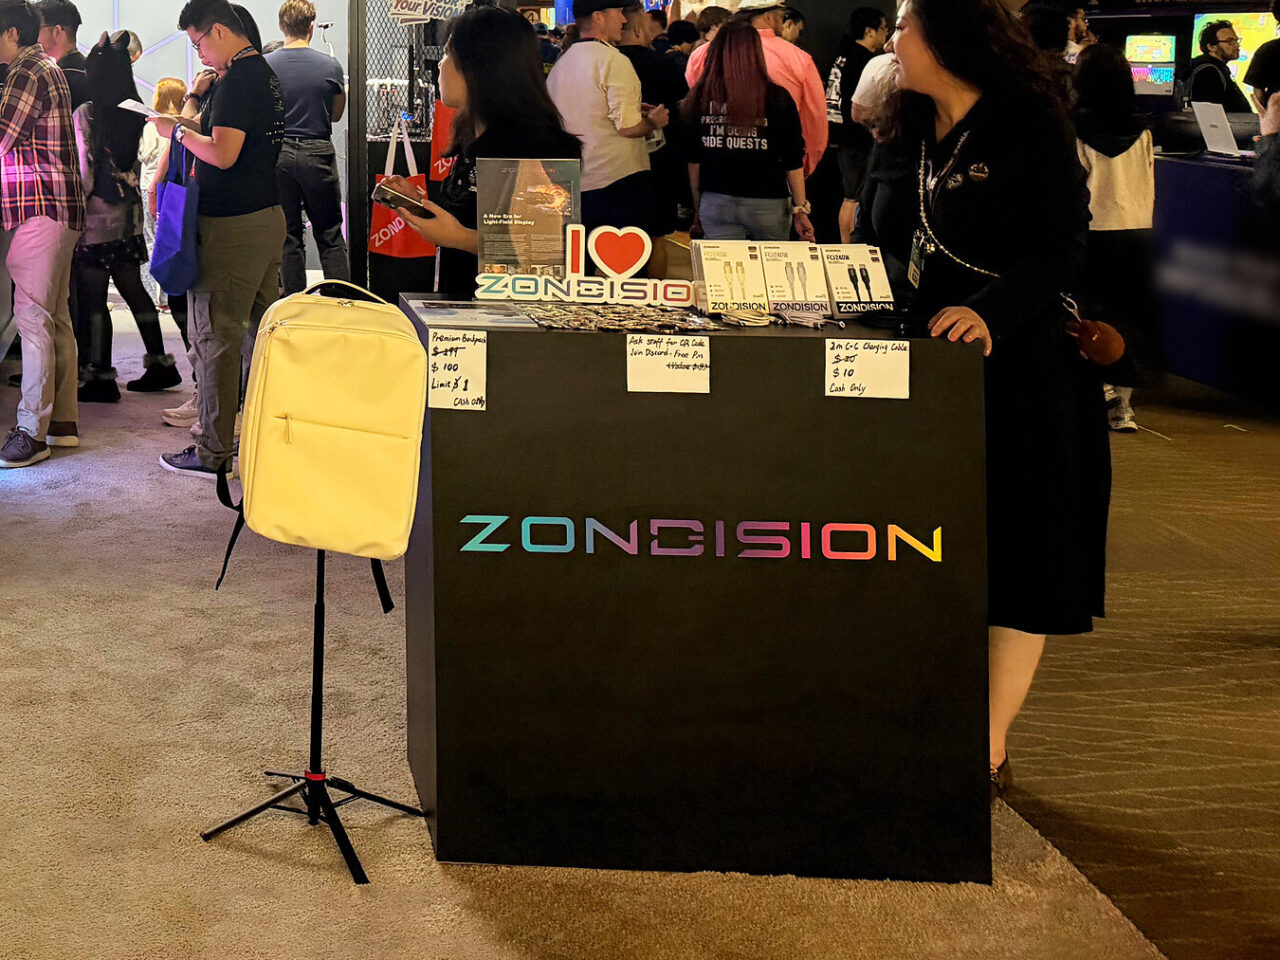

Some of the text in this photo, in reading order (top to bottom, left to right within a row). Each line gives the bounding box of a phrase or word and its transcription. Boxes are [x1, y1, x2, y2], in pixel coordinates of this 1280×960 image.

[710, 125, 724, 136] I'M
[702, 136, 768, 150] SIDE QUESTS
[571, 229, 580, 273] I
[481, 275, 691, 302] ZONDISIO
[711, 302, 766, 312] ZODISION
[773, 302, 828, 312] ZONDISION
[433, 332, 461, 342] Premium
[629, 336, 643, 345] Ask
[680, 339, 690, 347] QR
[692, 339, 705, 347] Code
[630, 348, 643, 356] Join
[674, 349, 689, 358] Free
[863, 342, 888, 354] Charging
[890, 343, 907, 351] Cable
[431, 378, 451, 389] Limit
[829, 383, 866, 395] Cash Only
